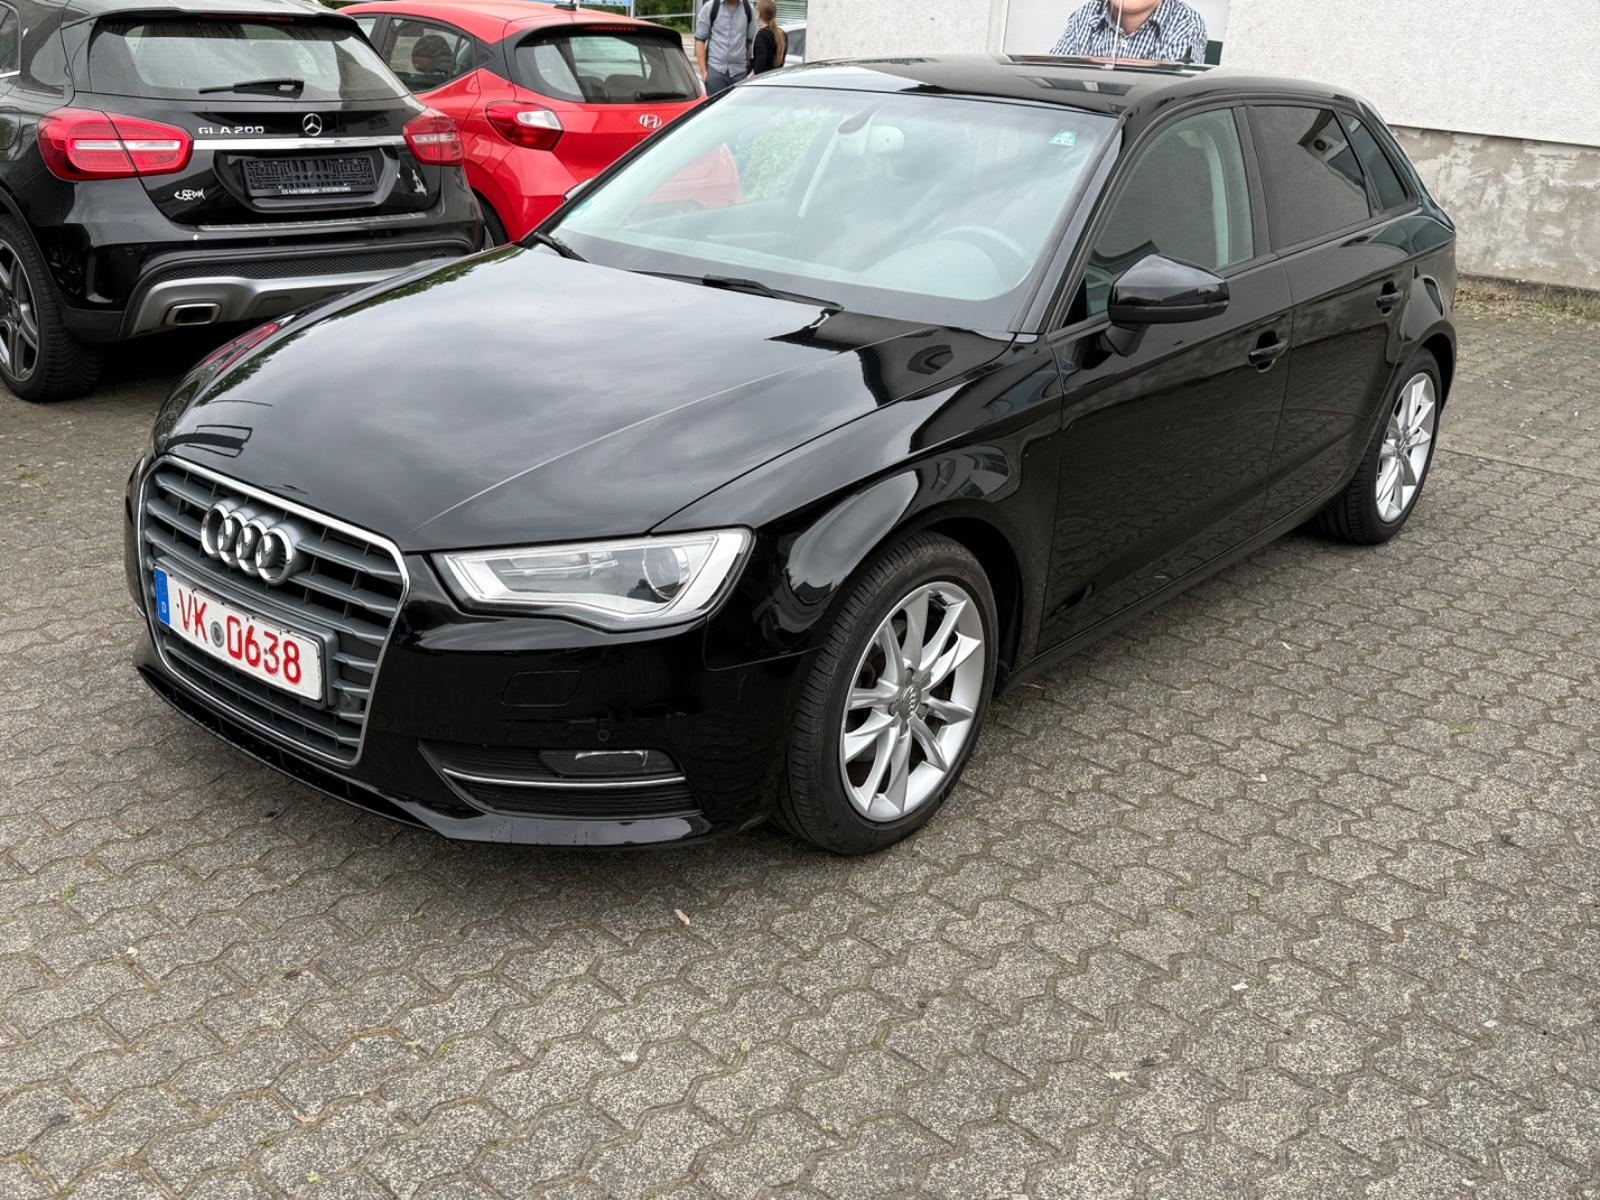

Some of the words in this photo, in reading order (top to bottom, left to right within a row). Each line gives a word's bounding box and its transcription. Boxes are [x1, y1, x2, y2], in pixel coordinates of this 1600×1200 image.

[198, 126, 231, 134] GLA
[234, 125, 265, 134] 200
[178, 588, 208, 643] VK
[226, 615, 302, 684] 0638
